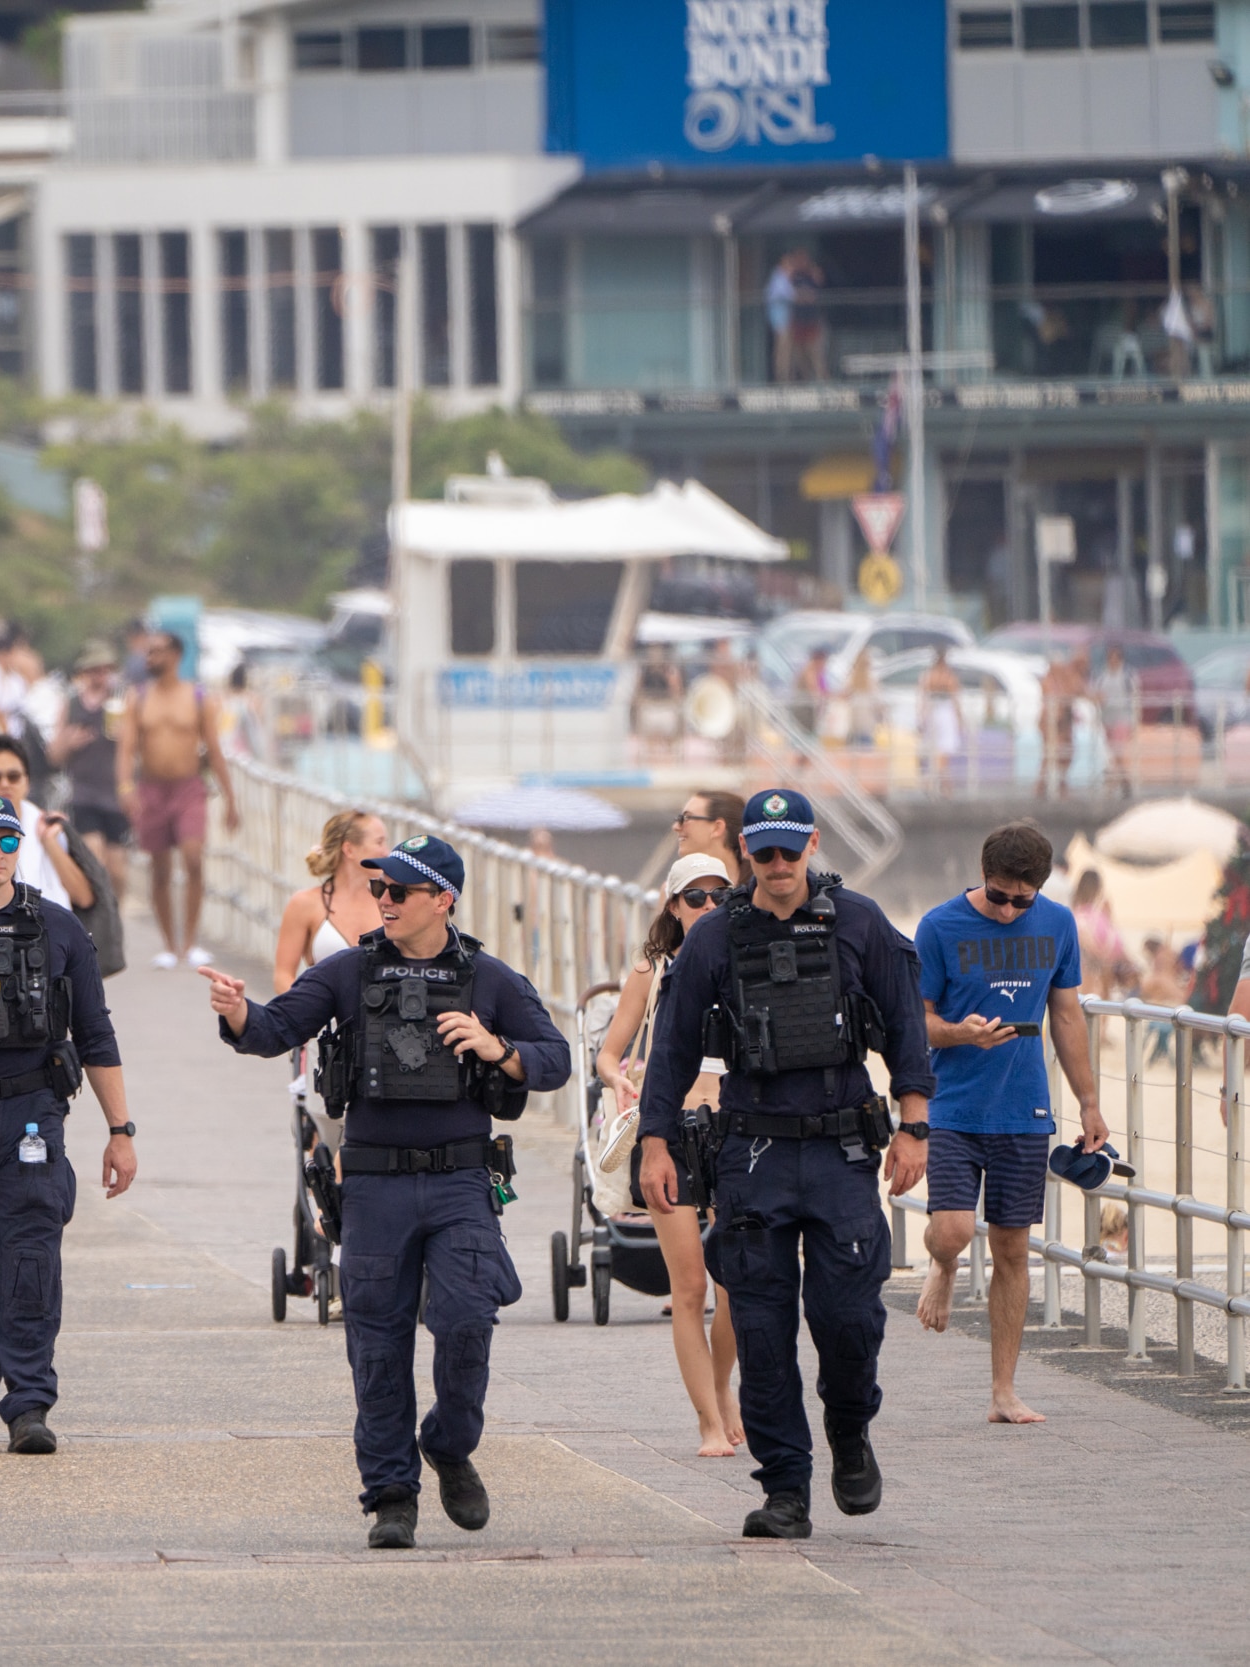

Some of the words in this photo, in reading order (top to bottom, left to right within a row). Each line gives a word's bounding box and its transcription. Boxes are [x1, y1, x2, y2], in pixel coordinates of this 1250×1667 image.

[685, 0, 829, 35] NORTH
[685, 37, 831, 87] BONDI
[793, 925, 827, 933] POLICE
[957, 936, 1056, 975] PUMA
[381, 967, 448, 980] POLICE
[990, 981, 1031, 989] SPORTSWEAR
